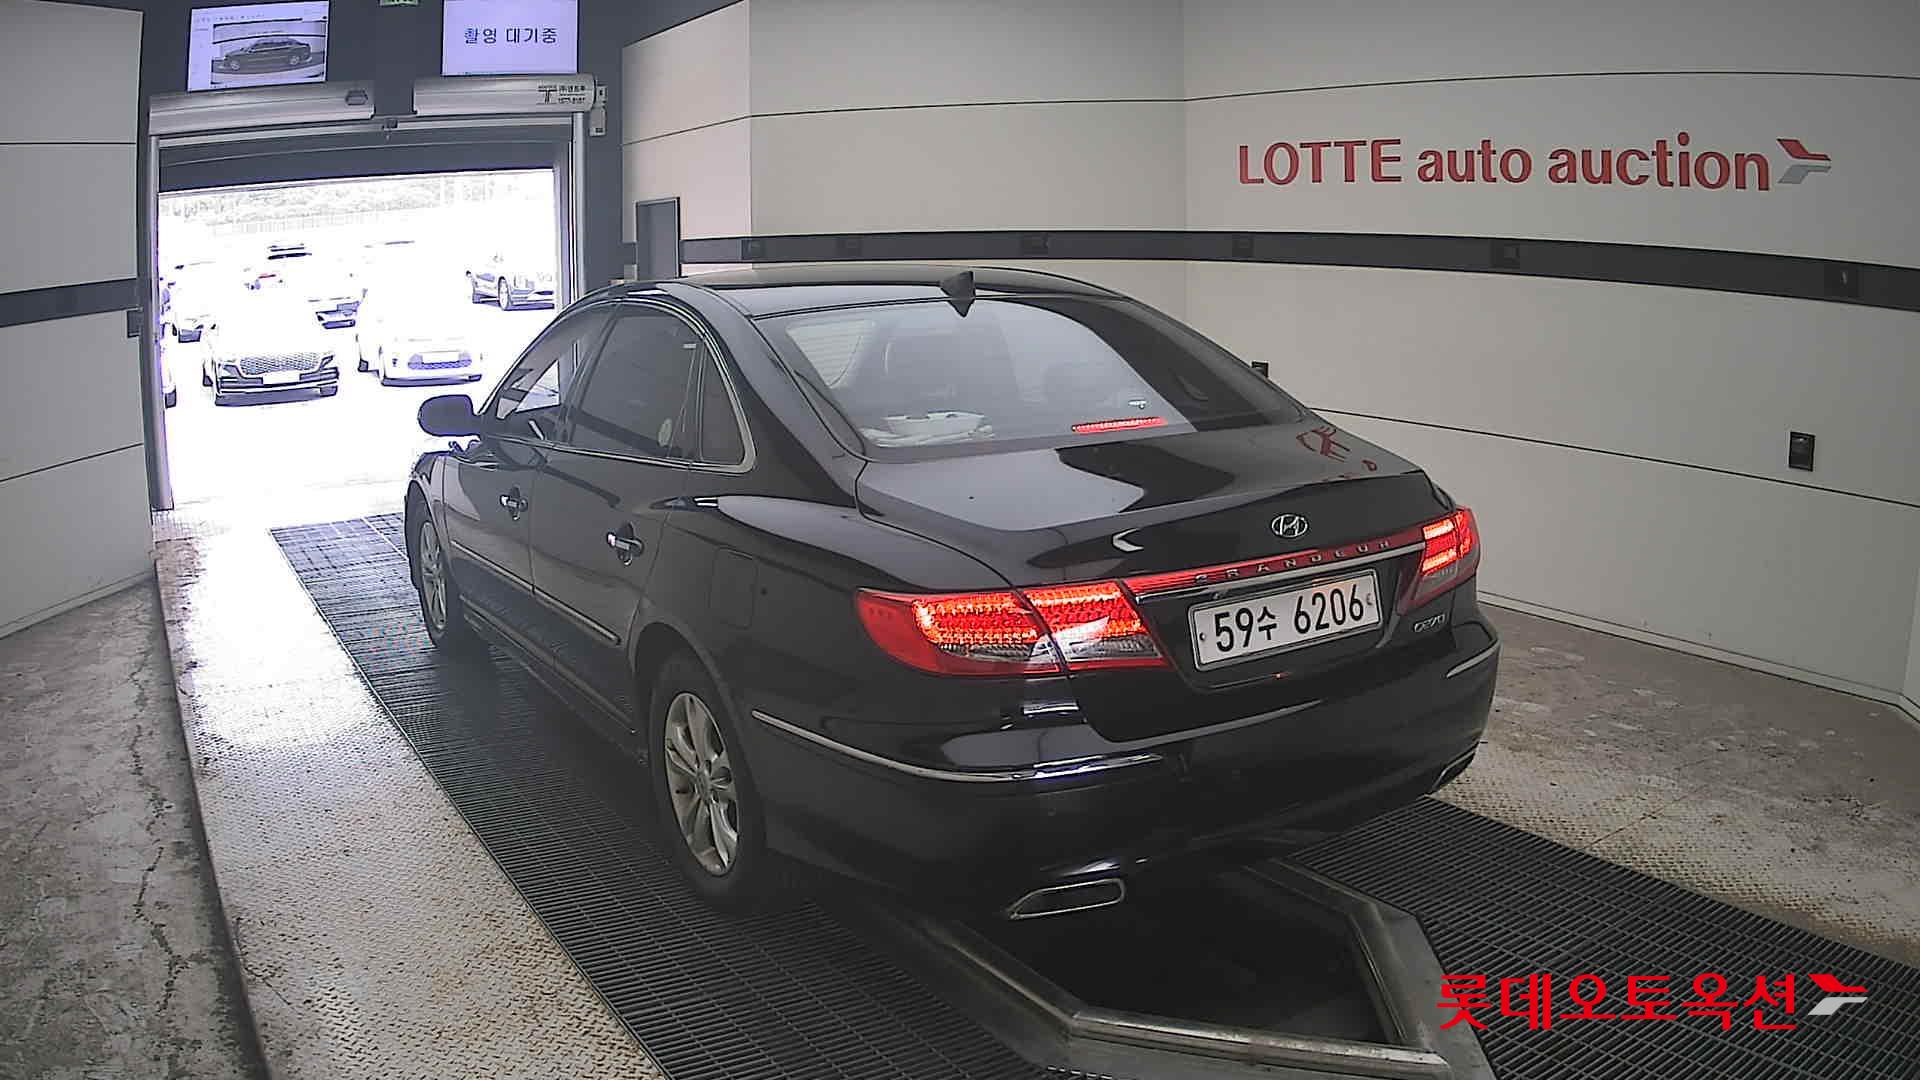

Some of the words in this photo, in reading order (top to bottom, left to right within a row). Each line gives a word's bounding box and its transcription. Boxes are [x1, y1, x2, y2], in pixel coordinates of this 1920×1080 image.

[464, 28, 496, 44] 촬영
[506, 28, 558, 44] 대기중
[1239, 138, 1401, 185] LOTTE
[1417, 139, 1532, 184] auto
[1549, 132, 1770, 191] auction
[1195, 540, 1390, 584] GRANDEUR
[1213, 606, 1277, 653] 59수
[1294, 584, 1364, 634] 6206
